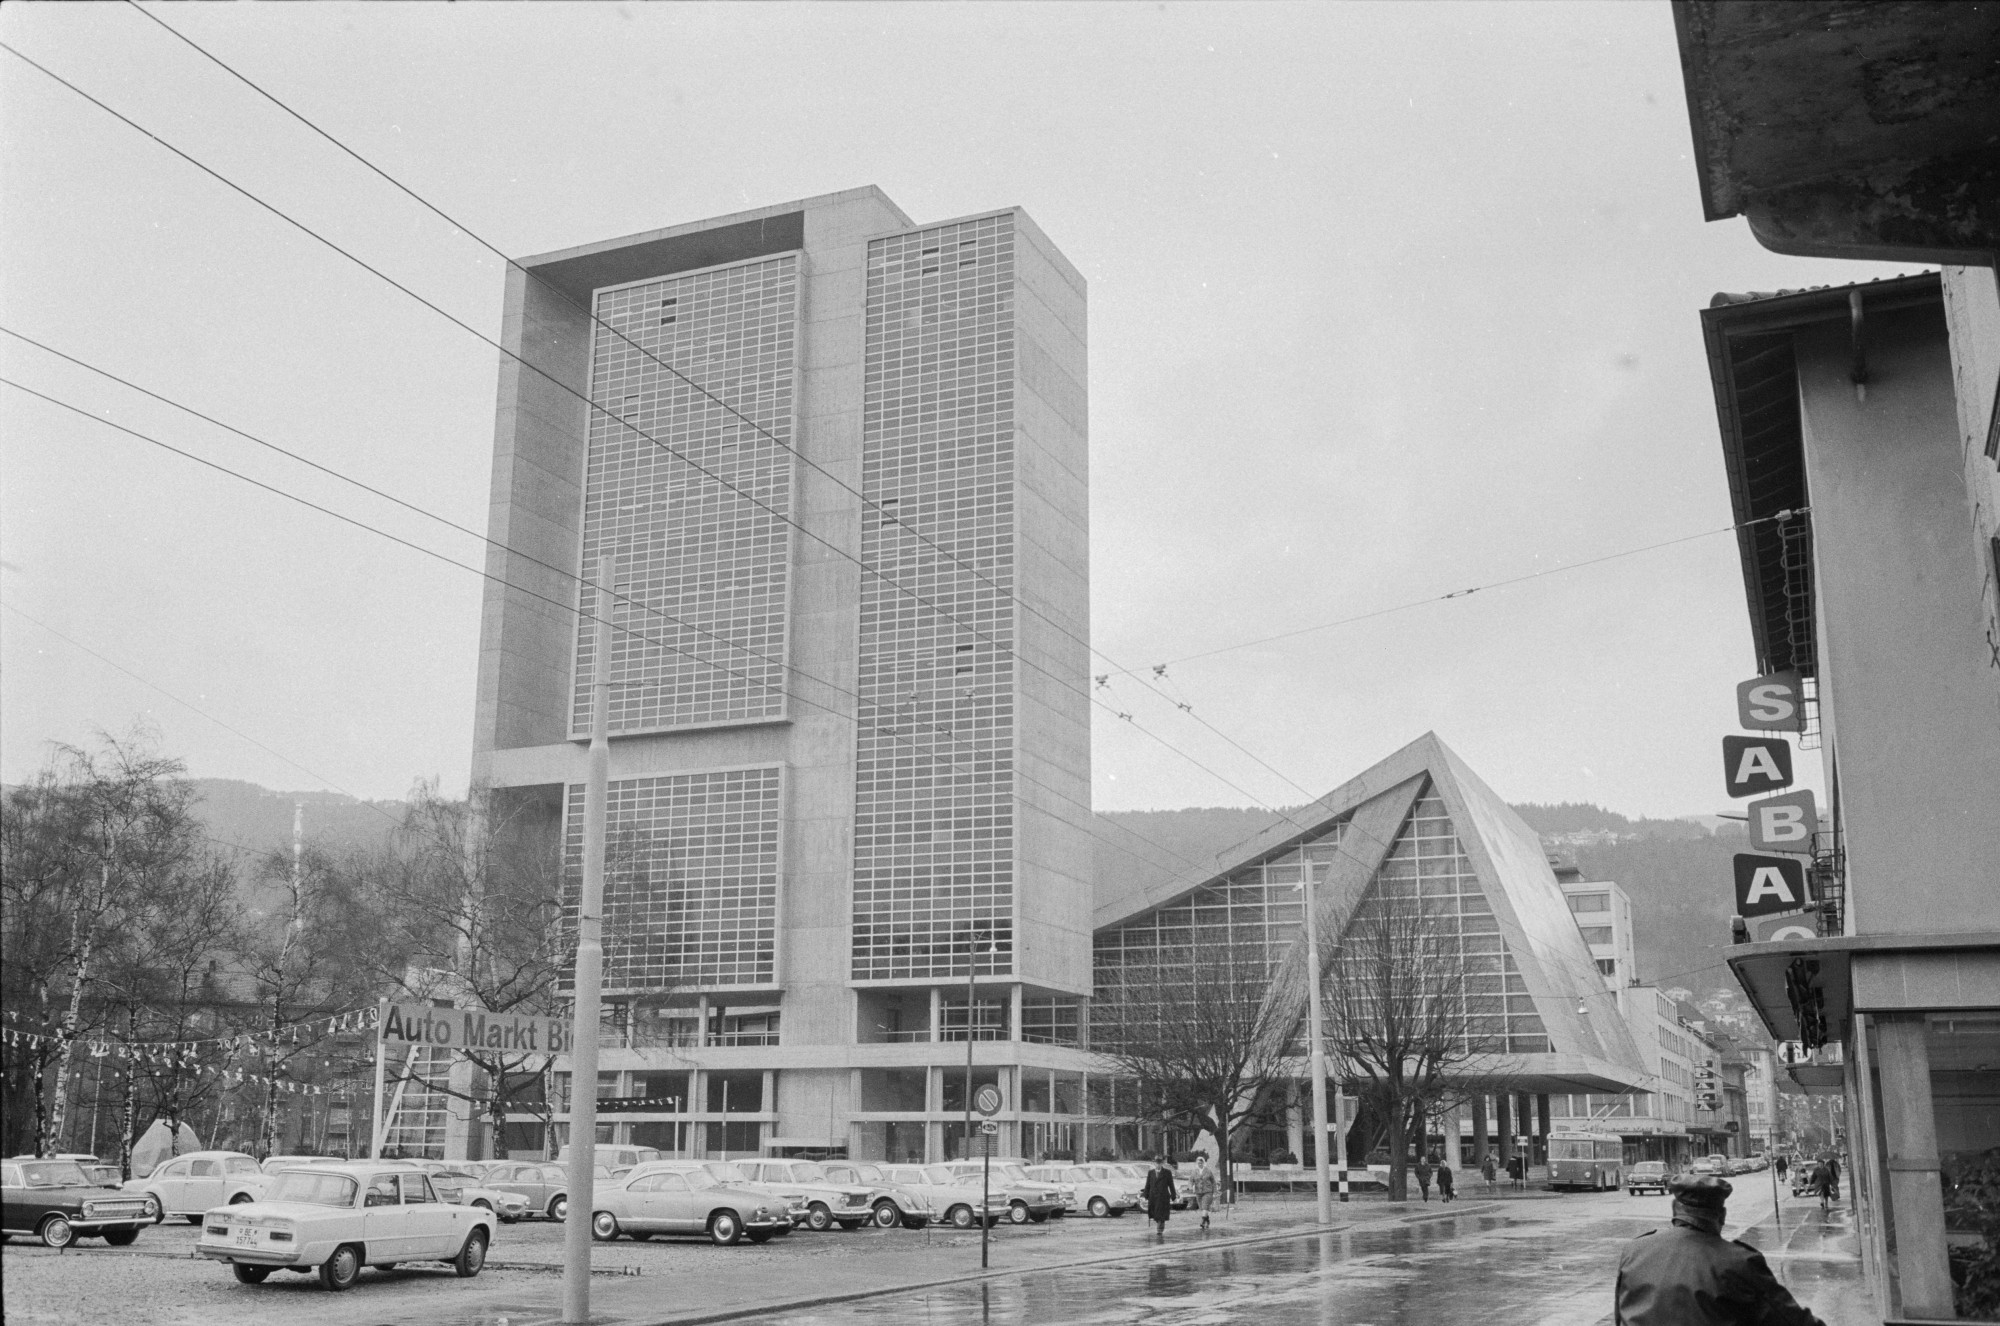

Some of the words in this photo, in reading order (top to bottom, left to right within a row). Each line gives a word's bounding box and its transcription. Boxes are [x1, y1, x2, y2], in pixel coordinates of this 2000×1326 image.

[1734, 684, 1817, 941] SABA
[382, 1005, 452, 1044] Auto
[463, 1012, 538, 1051] Markt
[547, 1019, 574, 1053] Bi
